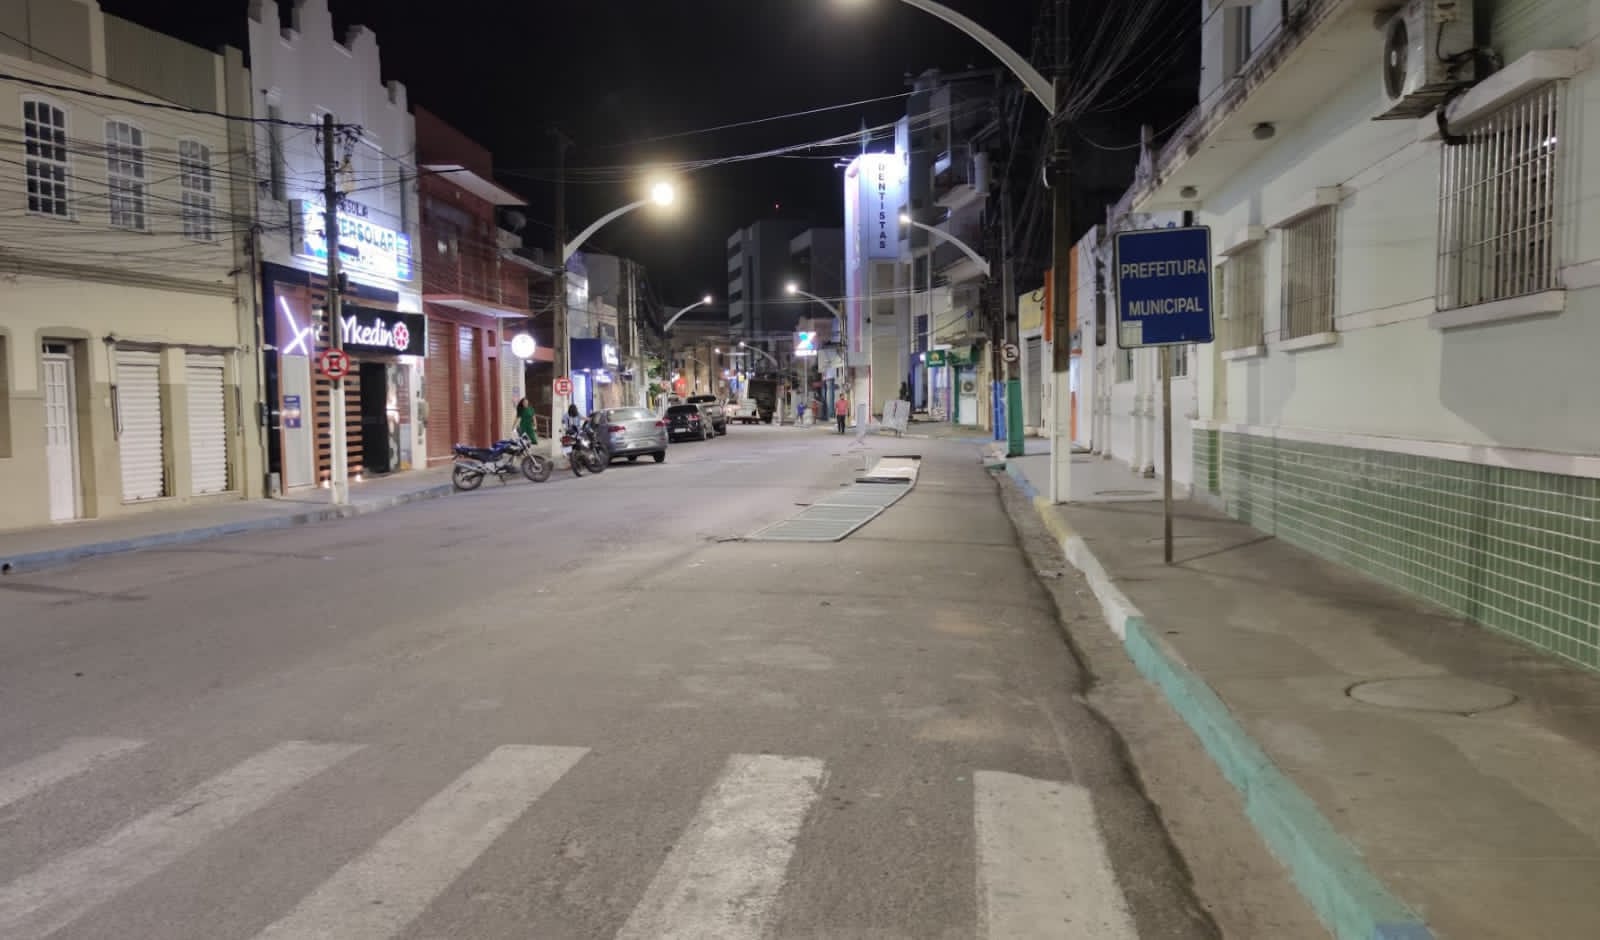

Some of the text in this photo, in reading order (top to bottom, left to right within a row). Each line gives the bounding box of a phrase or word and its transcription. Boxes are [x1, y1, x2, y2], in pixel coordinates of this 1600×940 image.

[878, 162, 887, 249] DENTISTAS
[1121, 259, 1207, 280] PREFEITURA
[1128, 296, 1205, 317] MUNICIPAL
